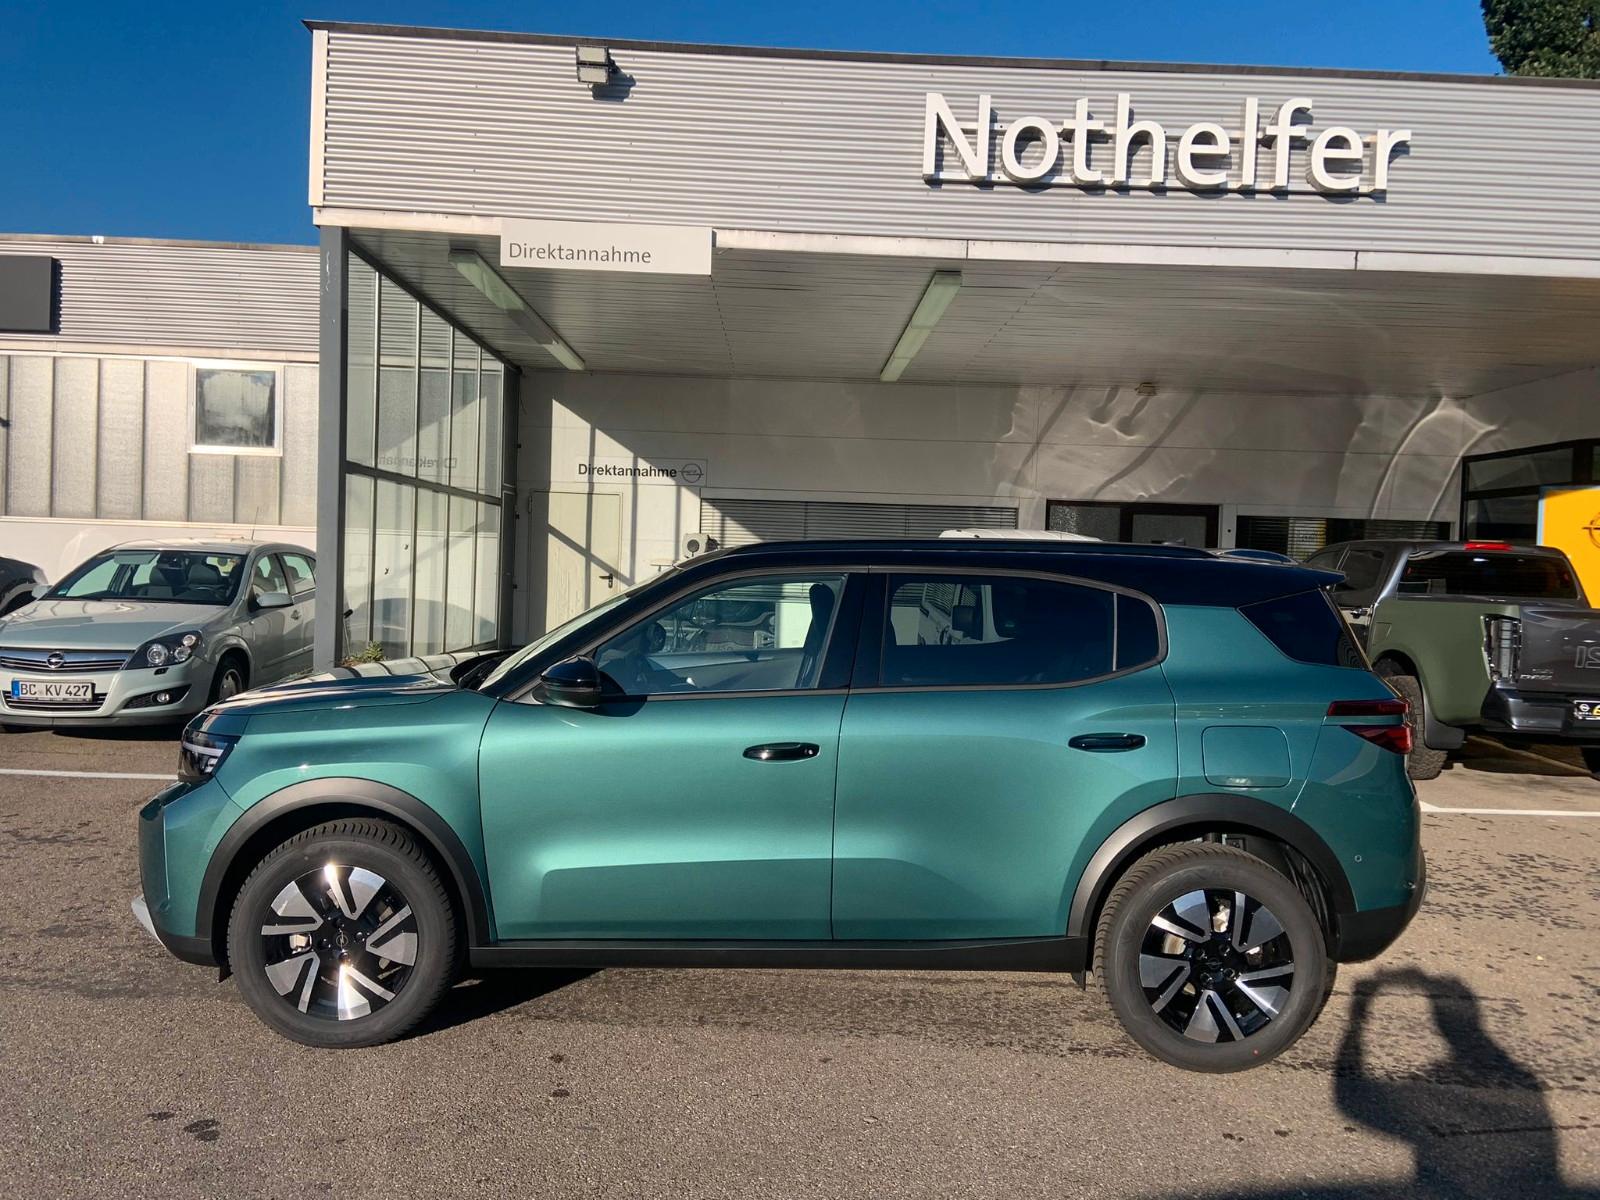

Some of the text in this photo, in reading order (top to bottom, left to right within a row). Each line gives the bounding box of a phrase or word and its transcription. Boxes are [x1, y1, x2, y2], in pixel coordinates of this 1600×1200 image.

[921, 92, 1412, 194] Nothelfer
[509, 242, 652, 264] Direktannahme
[578, 463, 678, 478] Direktannahme
[20, 683, 90, 697] BC KV 427
